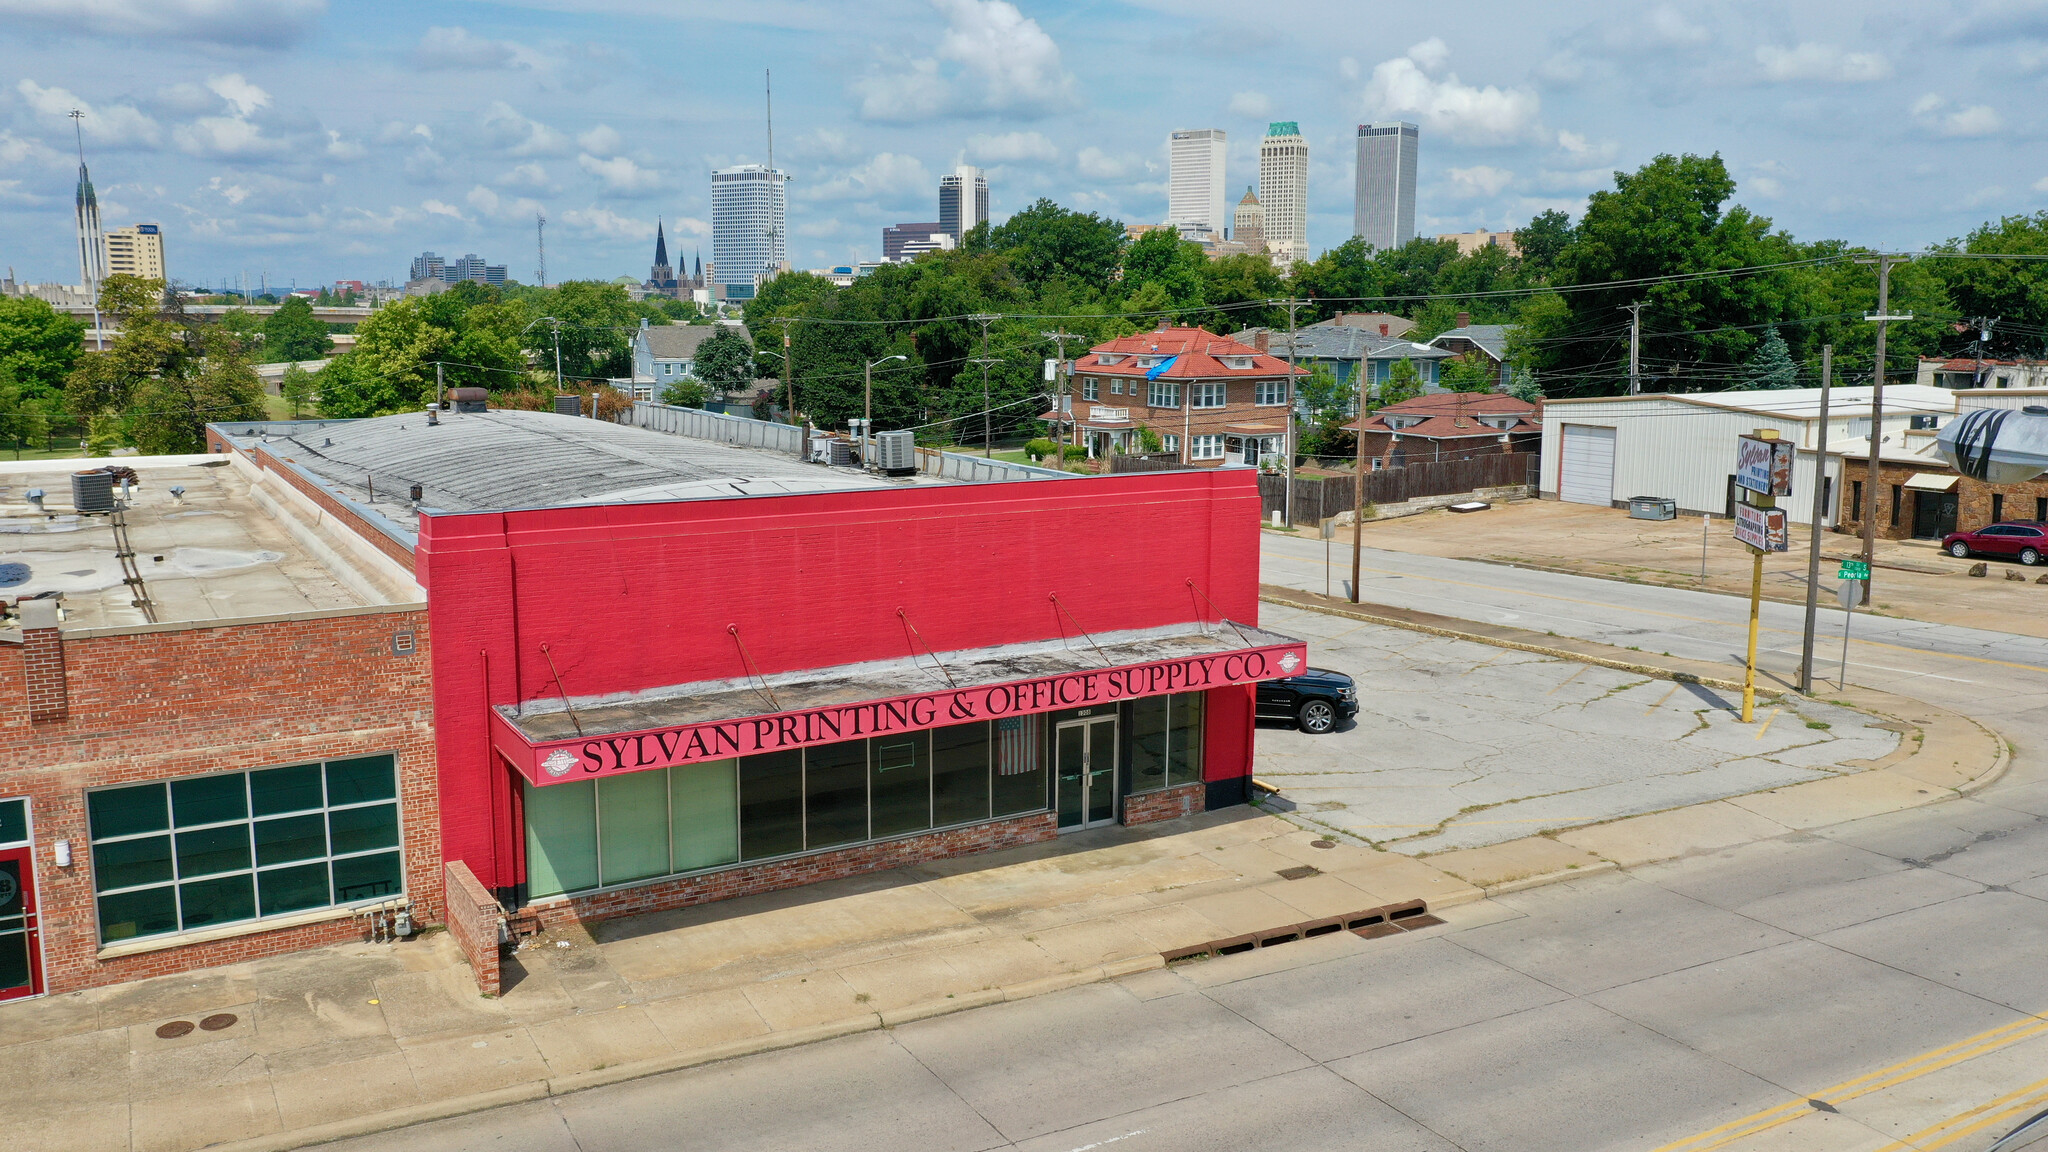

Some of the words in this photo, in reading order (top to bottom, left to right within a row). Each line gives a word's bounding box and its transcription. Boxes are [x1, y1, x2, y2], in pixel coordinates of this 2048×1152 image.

[1738, 441, 1769, 470] Sylvan
[1843, 571, 1862, 579] Peoria
[583, 722, 742, 773] SYLVAN
[752, 696, 936, 750] PRINTING
[948, 691, 976, 720] &
[985, 674, 1099, 715] OFFICE
[1108, 658, 1217, 698] SUPPLY
[1223, 653, 1271, 680] CO.
